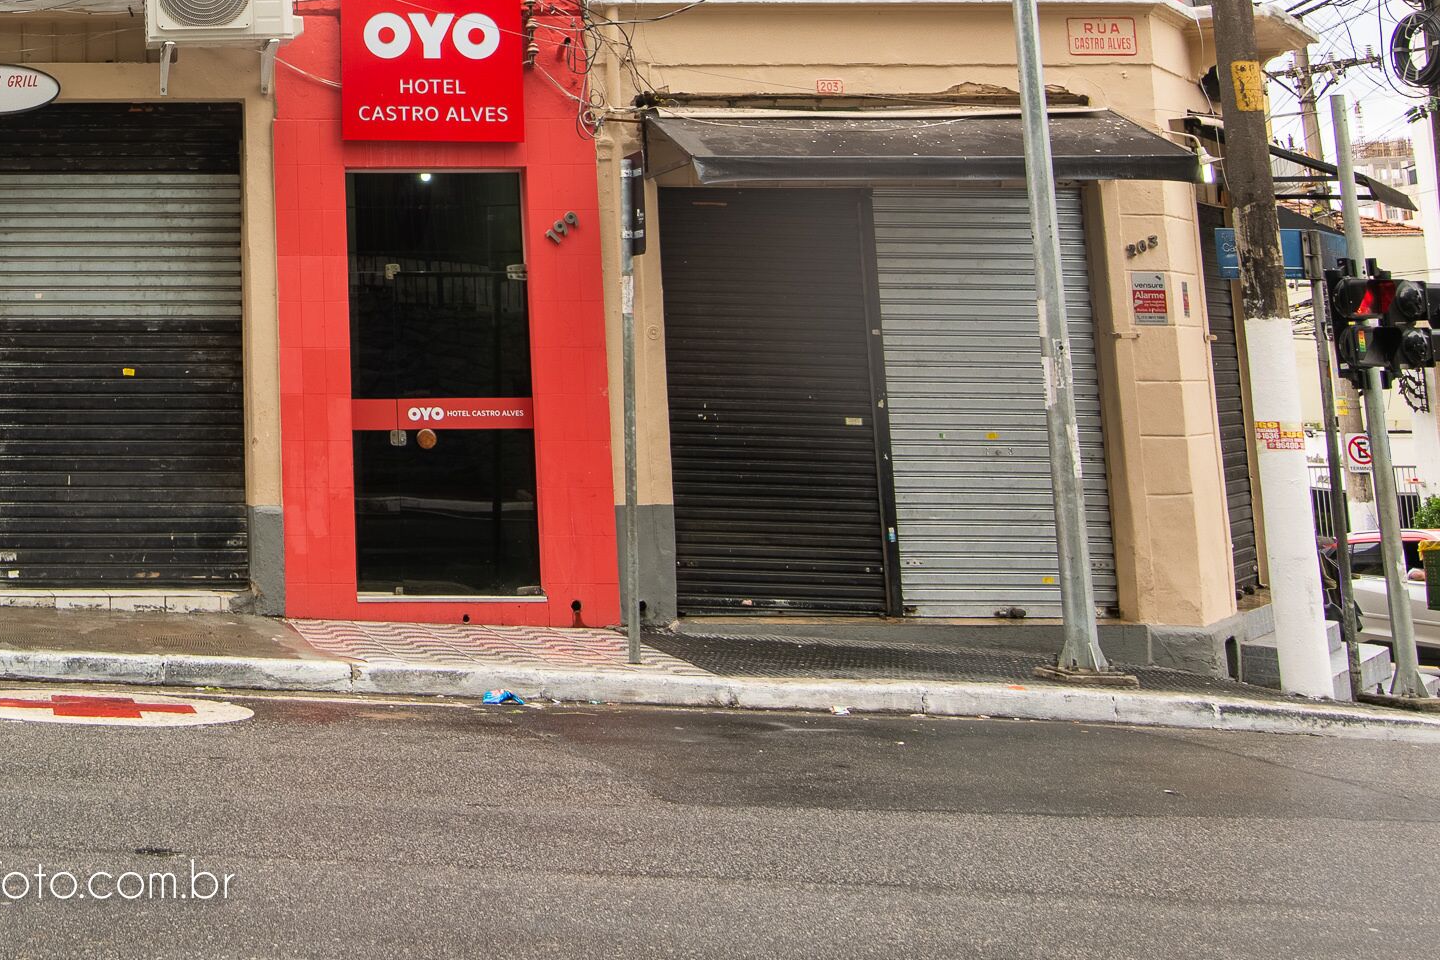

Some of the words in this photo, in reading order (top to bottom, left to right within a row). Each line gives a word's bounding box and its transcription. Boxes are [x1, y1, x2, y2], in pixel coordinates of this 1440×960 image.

[1083, 22, 1120, 34] RUA
[363, 12, 500, 60] OYO
[1074, 37, 1105, 50] CASTRO
[1108, 37, 1131, 50] ALVES
[7, 74, 38, 87] GRILL
[399, 78, 466, 94] HOTEL
[820, 81, 839, 92] 203
[358, 105, 439, 121] CASTRO
[445, 106, 509, 123] ALVES
[545, 210, 579, 244] 199
[1126, 234, 1158, 257] 203
[1135, 291, 1165, 300] Alarme
[408, 407, 444, 421] OYO
[447, 409, 471, 417] HOTEL
[472, 409, 501, 417] CASTRO
[502, 409, 524, 417] ALVES
